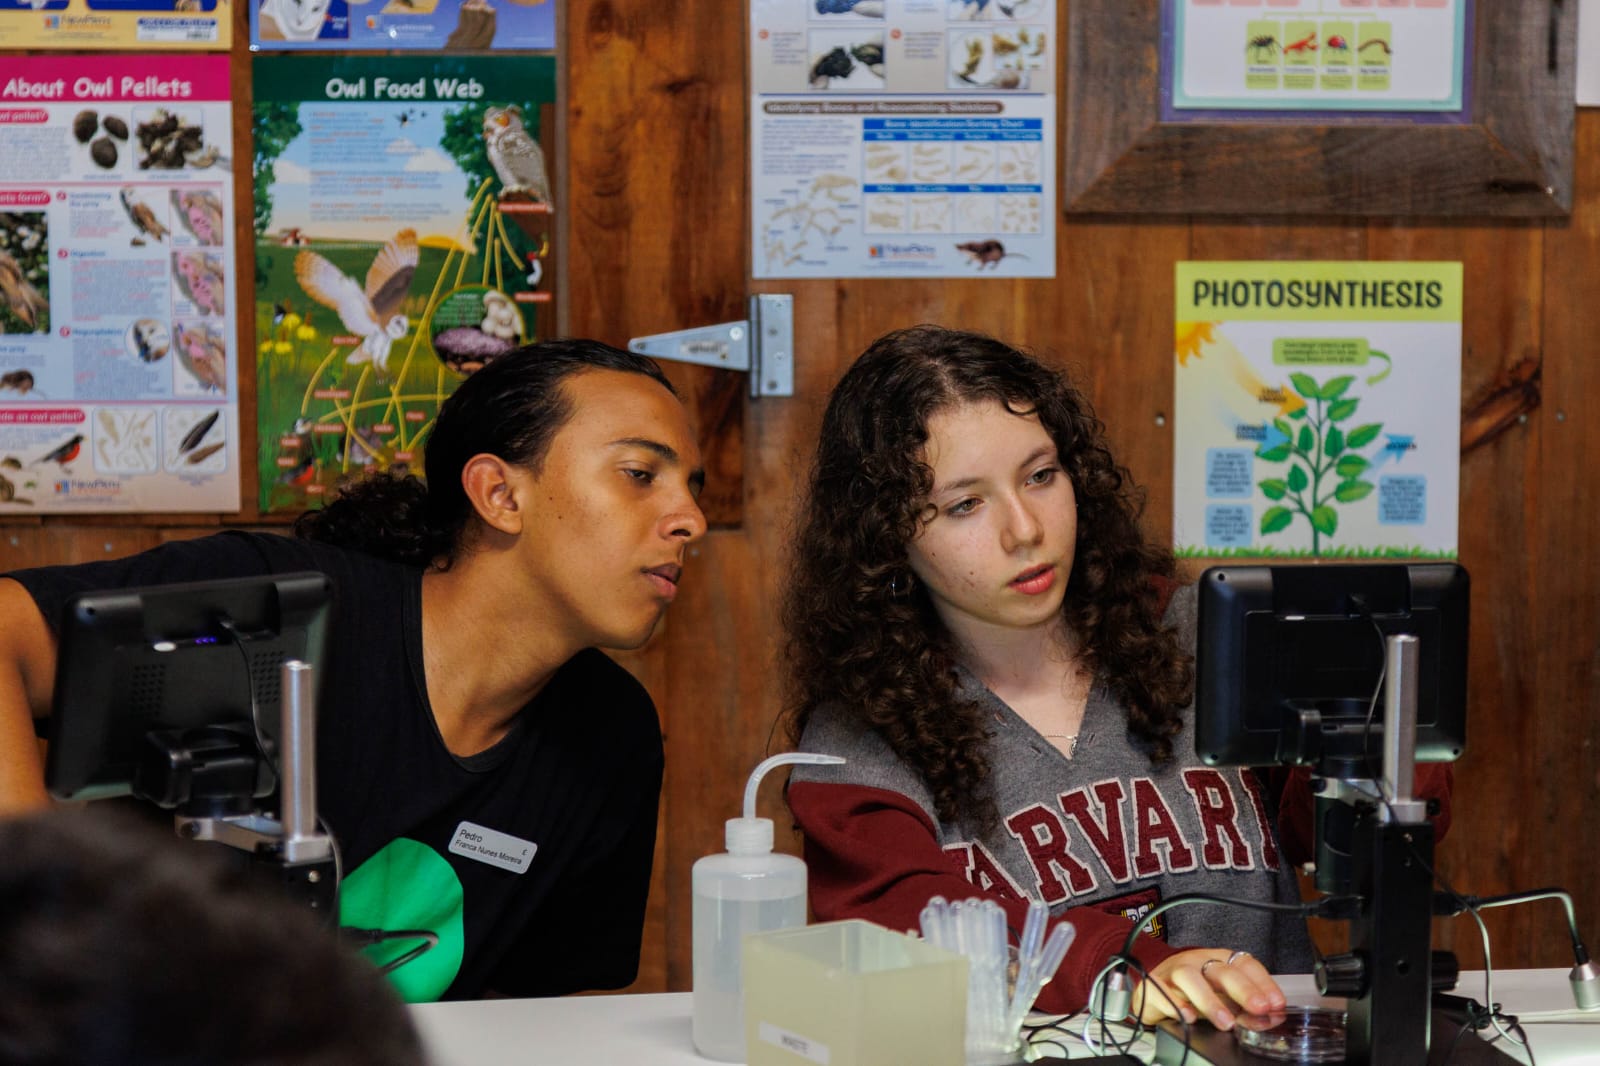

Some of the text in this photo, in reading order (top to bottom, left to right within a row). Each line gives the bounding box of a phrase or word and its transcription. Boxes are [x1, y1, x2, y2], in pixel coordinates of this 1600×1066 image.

[3, 76, 191, 98] About Owl Pellets
[325, 77, 484, 99] Owl Food Web
[1193, 279, 1443, 308] PHOTOSYNTHESIS
[459, 829, 483, 843] Pedro
[943, 767, 1280, 906] ARVAR
[477, 845, 498, 858] Nunes
